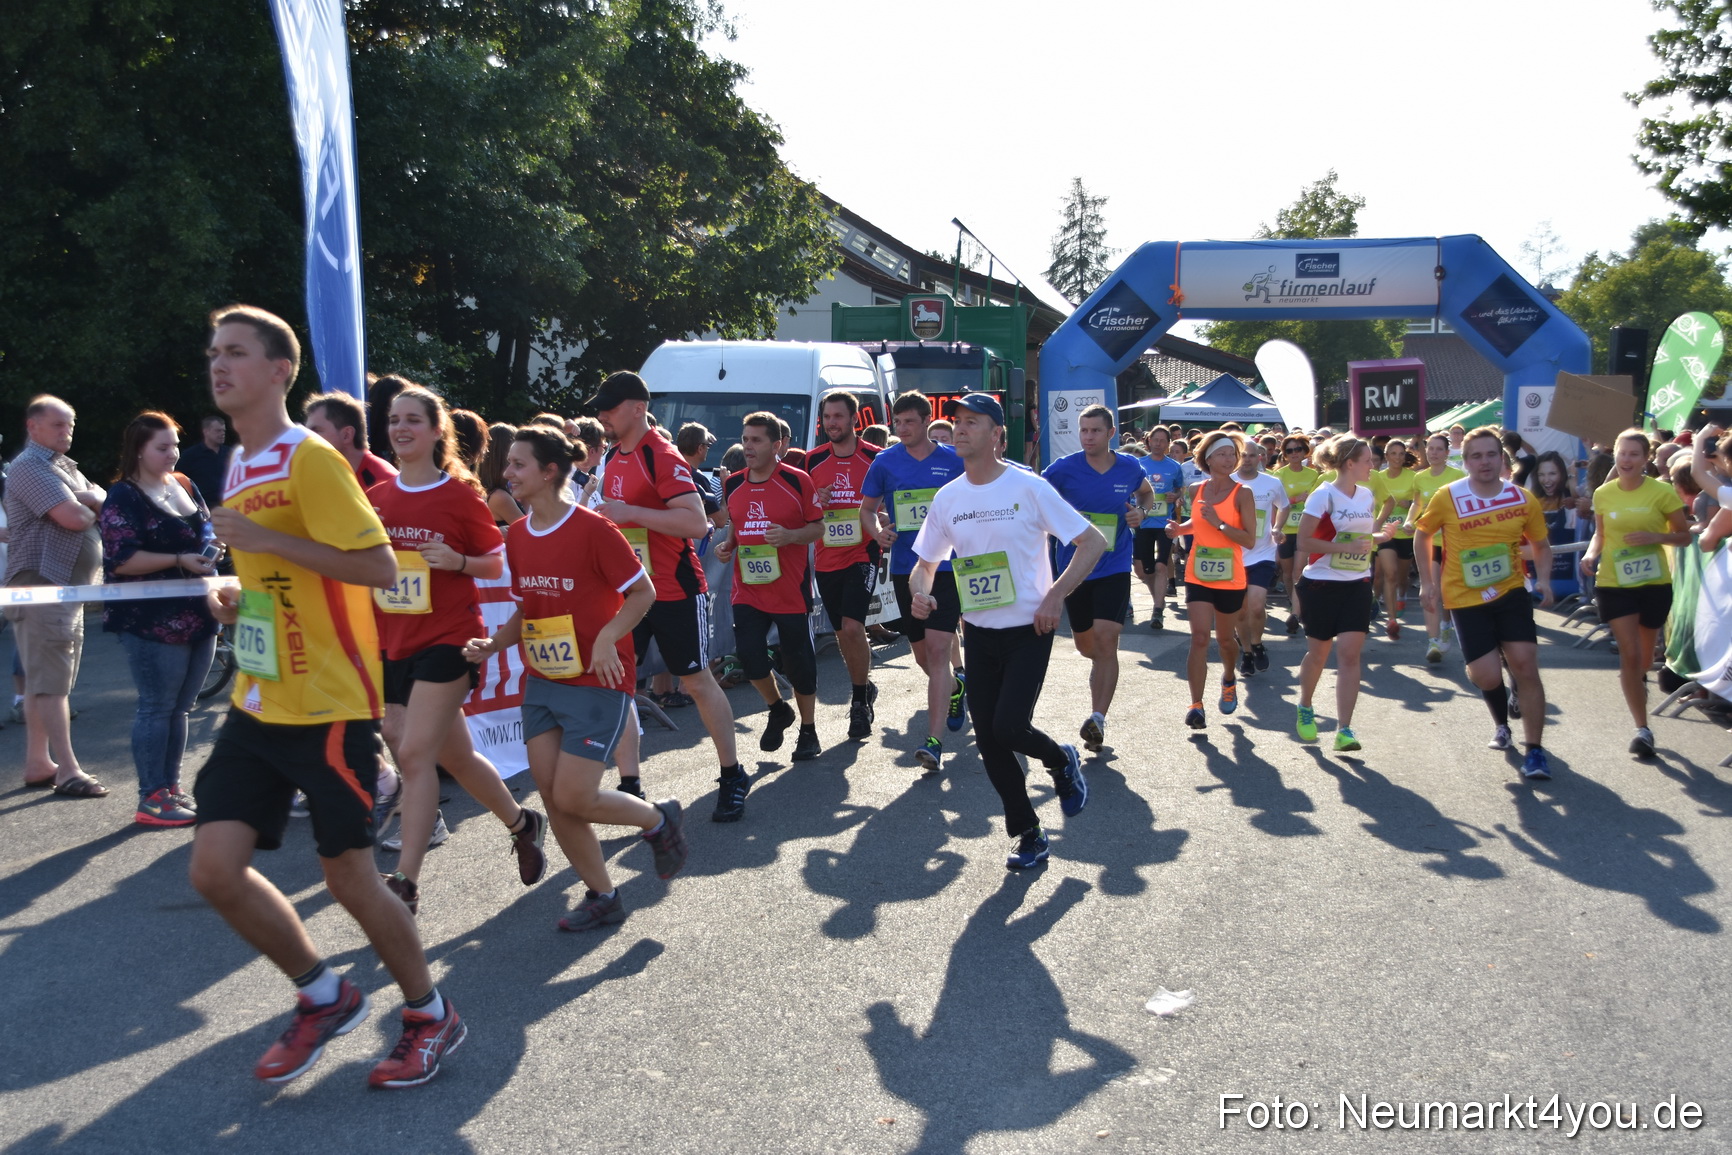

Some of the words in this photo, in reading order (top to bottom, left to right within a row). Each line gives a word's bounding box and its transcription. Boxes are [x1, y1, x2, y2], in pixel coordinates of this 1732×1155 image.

[1304, 261, 1337, 271] Fischer
[1279, 277, 1376, 297] firmenlauf
[1278, 296, 1319, 304] neumarkt
[1100, 315, 1149, 327] Fischer
[1103, 324, 1144, 332] AUTOMOBILE
[1364, 385, 1400, 409] RW
[1650, 380, 1682, 412] AOK
[1184, 410, 1264, 418] www.fischer-automobile.de
[1365, 413, 1414, 422] RAUMWERK
[243, 489, 292, 516] BÖGL
[909, 505, 929, 519] 13
[952, 506, 1015, 525] globalconcepts
[1291, 512, 1302, 521] 67
[1460, 516, 1492, 531] MAX
[1495, 507, 1528, 523] BÖGL
[828, 523, 854, 537] 968
[747, 560, 772, 574] 966
[1199, 561, 1225, 573] 675
[1470, 560, 1502, 579] 915
[1623, 559, 1653, 577] 672
[969, 574, 1001, 596] 527
[239, 624, 266, 655] 876
[529, 641, 574, 663] 1412
[478, 719, 524, 748] www.m
